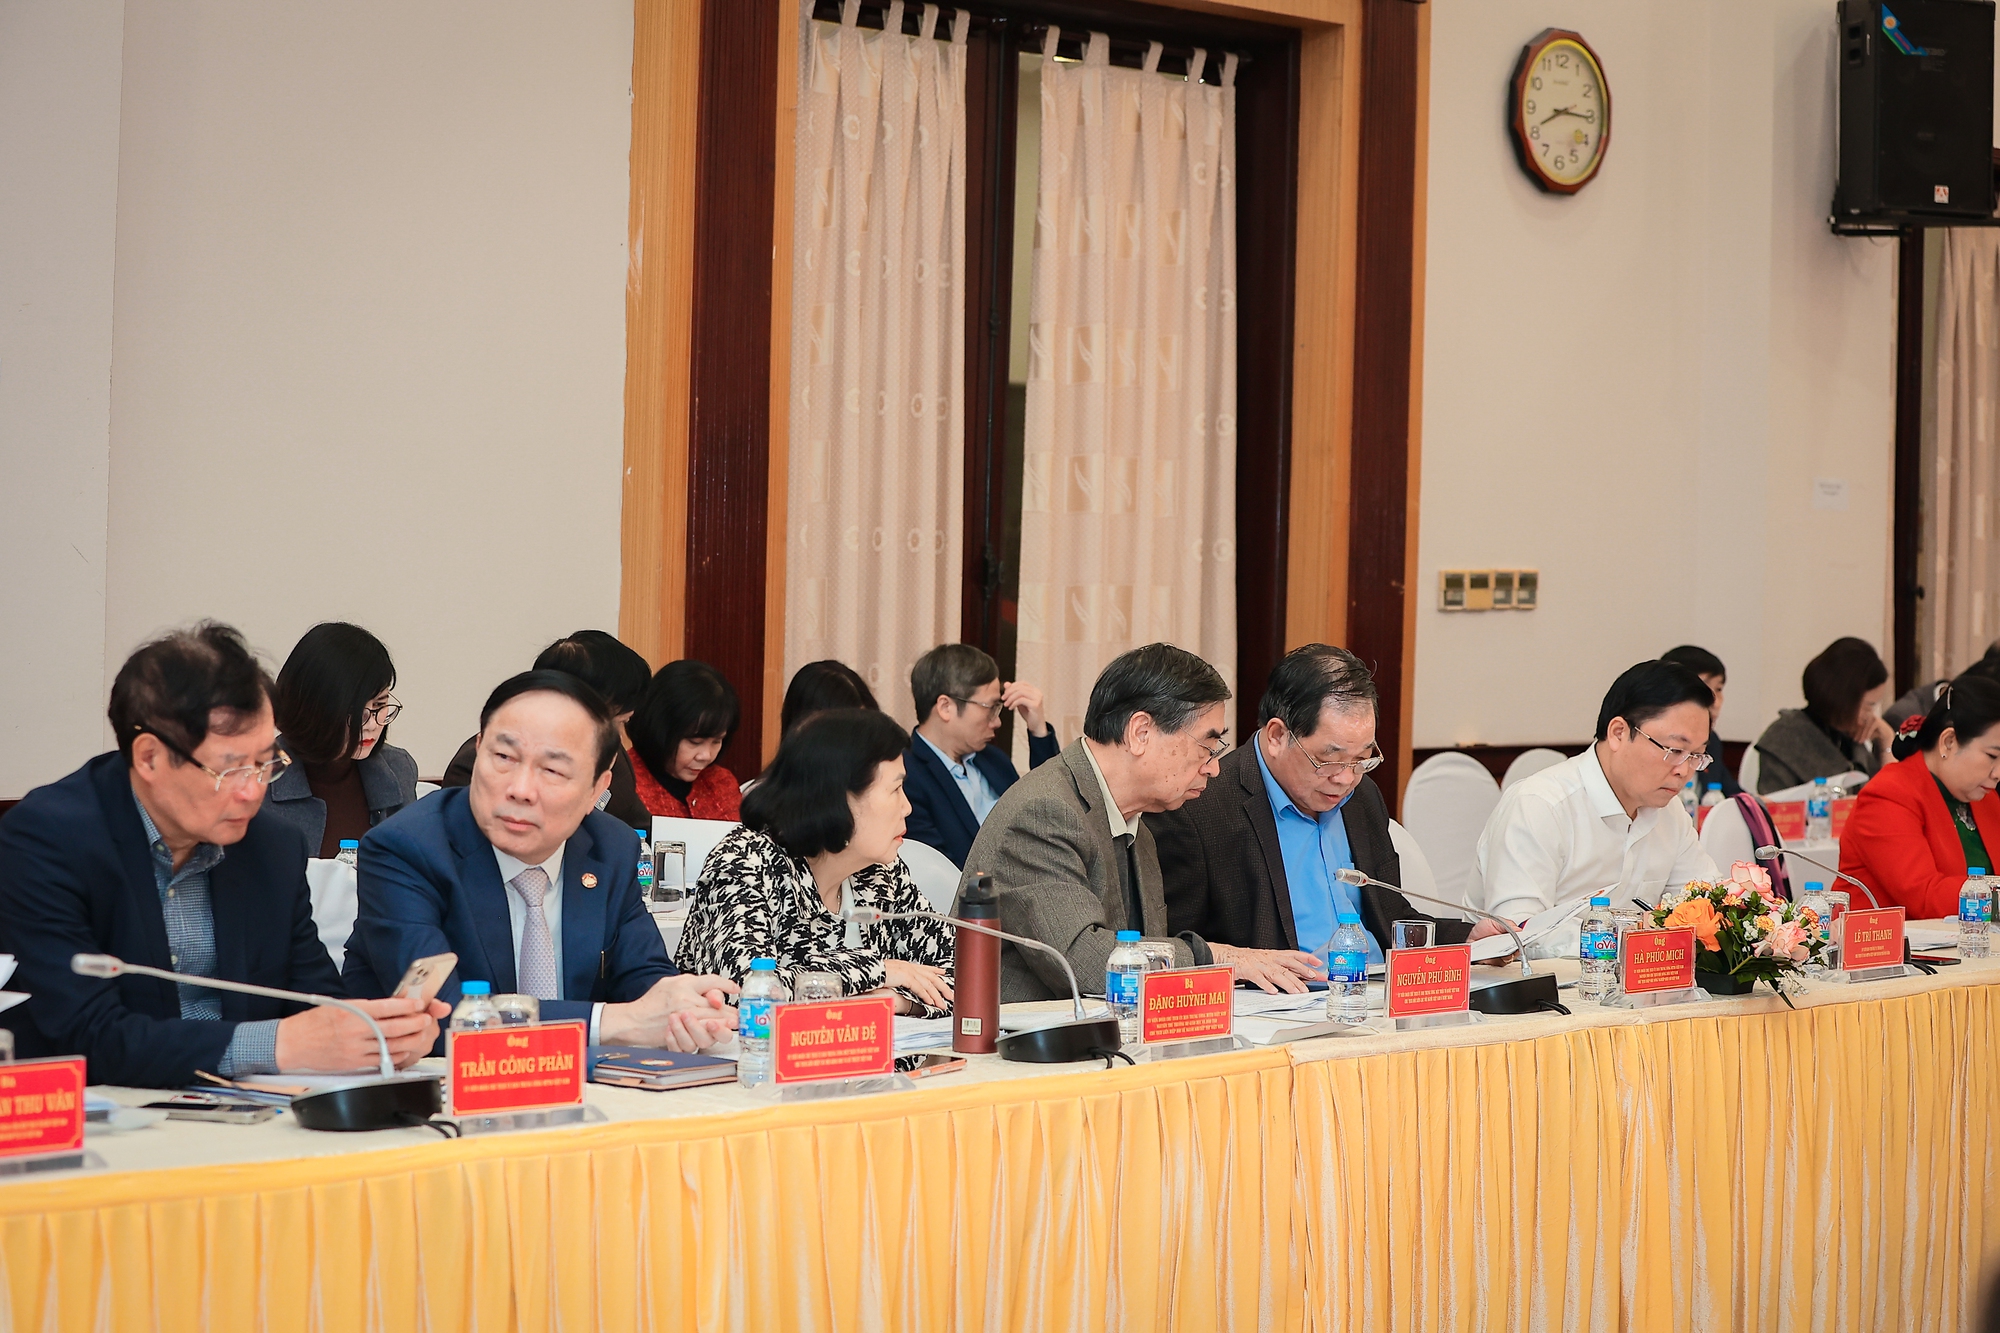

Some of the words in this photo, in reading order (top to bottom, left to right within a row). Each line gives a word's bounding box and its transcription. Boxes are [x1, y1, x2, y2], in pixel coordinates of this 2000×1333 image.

[1542, 58, 1552, 72] 11
[1555, 54, 1570, 69] 12
[1575, 64, 1580, 77] 1
[1531, 77, 1543, 91] 10
[1583, 84, 1593, 98] 2
[1526, 99, 1536, 115] 9
[1585, 109, 1595, 124] 3
[1530, 126, 1540, 140] 8
[1541, 143, 1550, 157] 7
[1569, 149, 1579, 164] 5
[1554, 155, 1565, 170] 6
[1655, 935, 1665, 946] Ông
[1862, 927, 1871, 942] TRÍ
[1872, 929, 1893, 941] THANH
[1425, 955, 1437, 964] Ông
[1634, 949, 1644, 964] HÀ
[1645, 947, 1665, 963] PHÚC
[1666, 949, 1684, 963] MỊCH
[1185, 978, 1193, 988] Bà
[1396, 966, 1426, 987] NGUYỄN
[1427, 967, 1443, 984] PHÚ
[1444, 966, 1462, 982] BÌNH
[1149, 994, 1175, 1013] ĐẶNG
[1176, 990, 1207, 1008] HUỲNH
[1208, 991, 1226, 1005] MAI
[861, 1021, 877, 1044] ĐỆ
[498, 1054, 536, 1076] CÔNG
